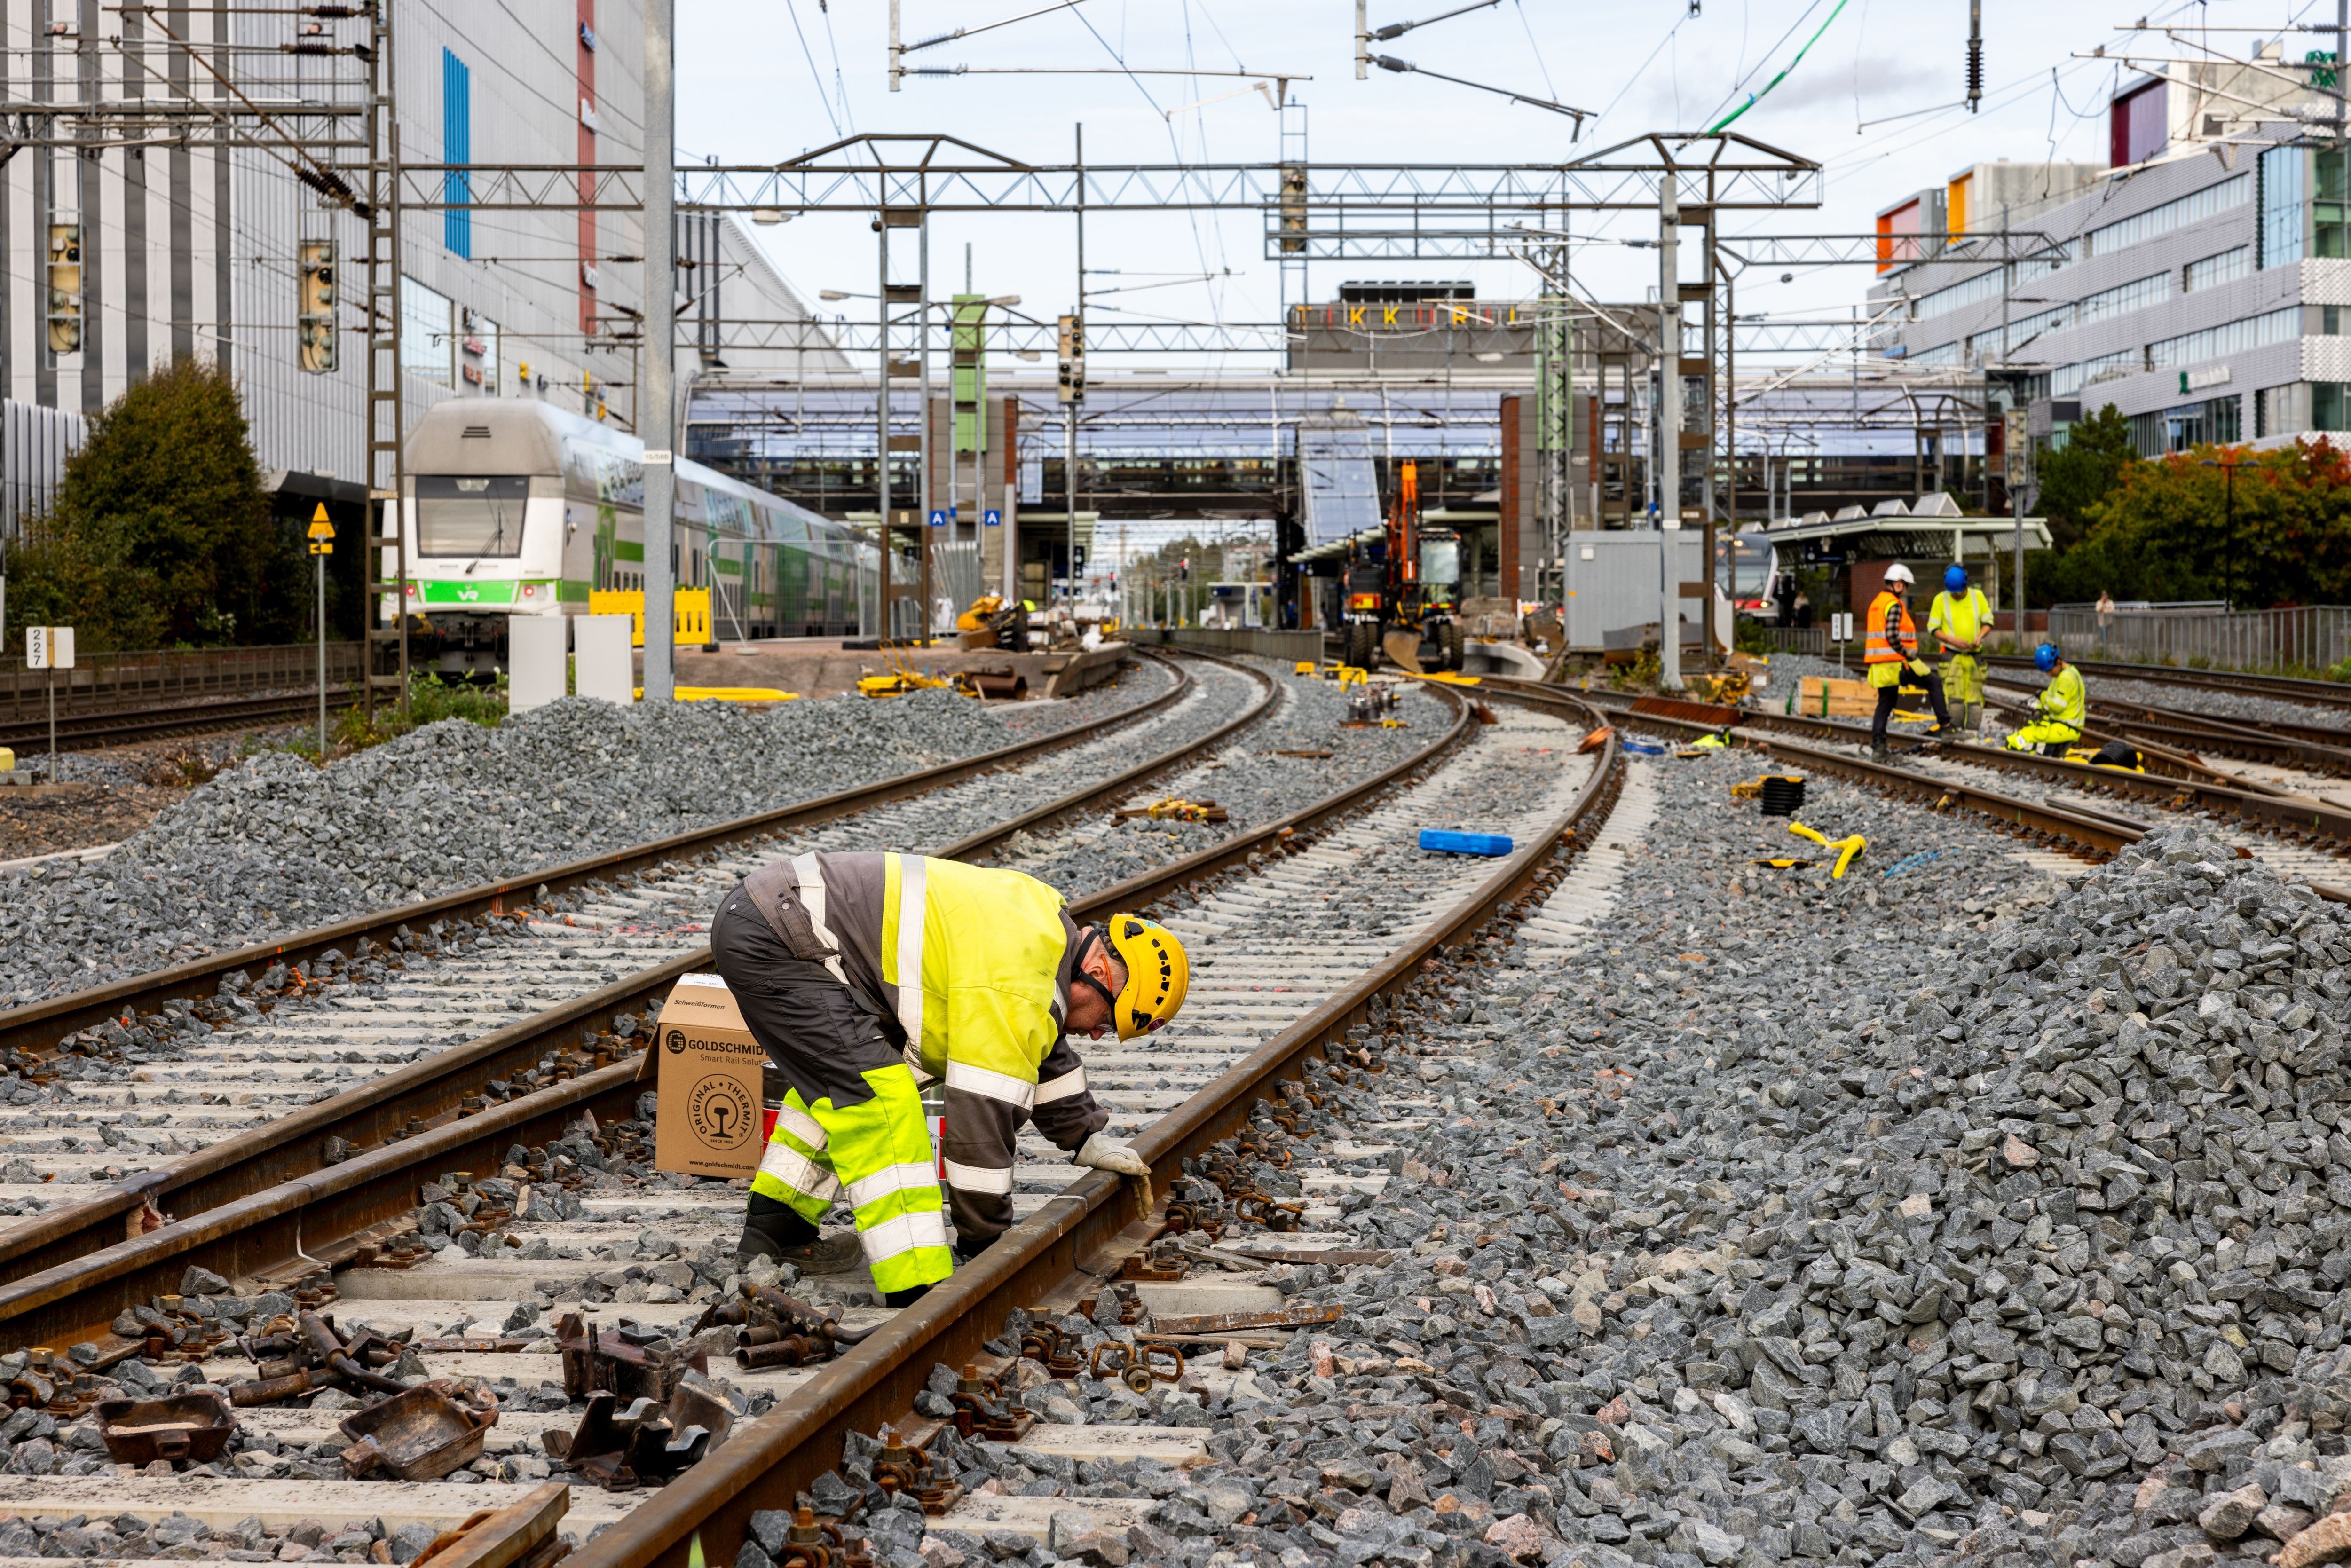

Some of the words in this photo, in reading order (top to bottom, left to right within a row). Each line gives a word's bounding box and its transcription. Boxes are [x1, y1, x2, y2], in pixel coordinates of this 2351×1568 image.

[932, 512, 943, 525] A
[987, 512, 998, 524] A
[457, 590, 479, 601] VR
[674, 999, 725, 1009] Schweißformen
[688, 1039, 768, 1056] GOLDSCHMID
[700, 1054, 723, 1063] Smart
[726, 1056, 740, 1064] Rail
[693, 1081, 716, 1135] ORIGINAL
[689, 1159, 755, 1171] www.goldschmidt.com
